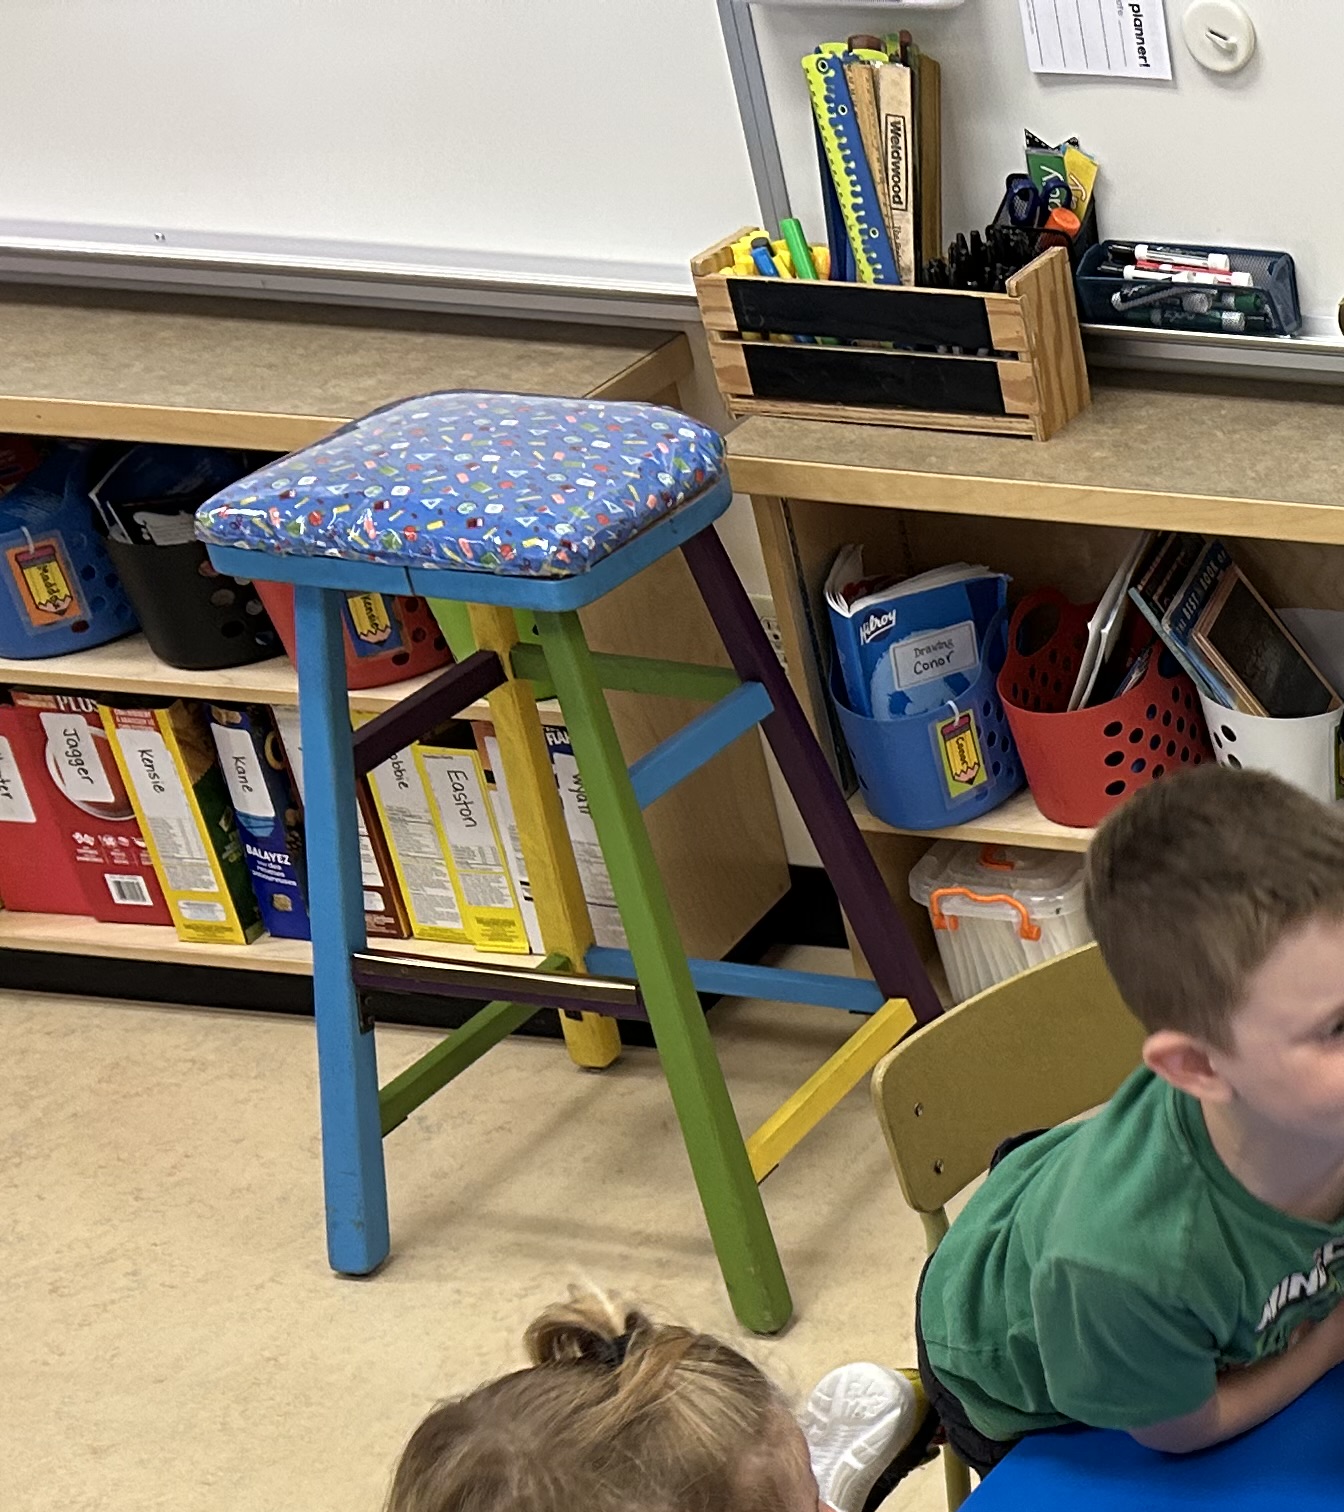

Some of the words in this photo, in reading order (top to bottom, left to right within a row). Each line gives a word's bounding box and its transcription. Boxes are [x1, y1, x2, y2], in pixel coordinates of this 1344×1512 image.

[1128, 3, 1150, 68] planner!
[890, 120, 903, 206] Weldwood
[1183, 592, 1200, 620] BEST
[913, 650, 955, 675] Conor
[64, 728, 94, 785] Jagger
[138, 749, 165, 794] Kensie
[232, 755, 253, 793] Kane
[390, 751, 409, 790] obbie
[447, 769, 477, 828] Easton
[247, 843, 291, 866] BALAYEZ
